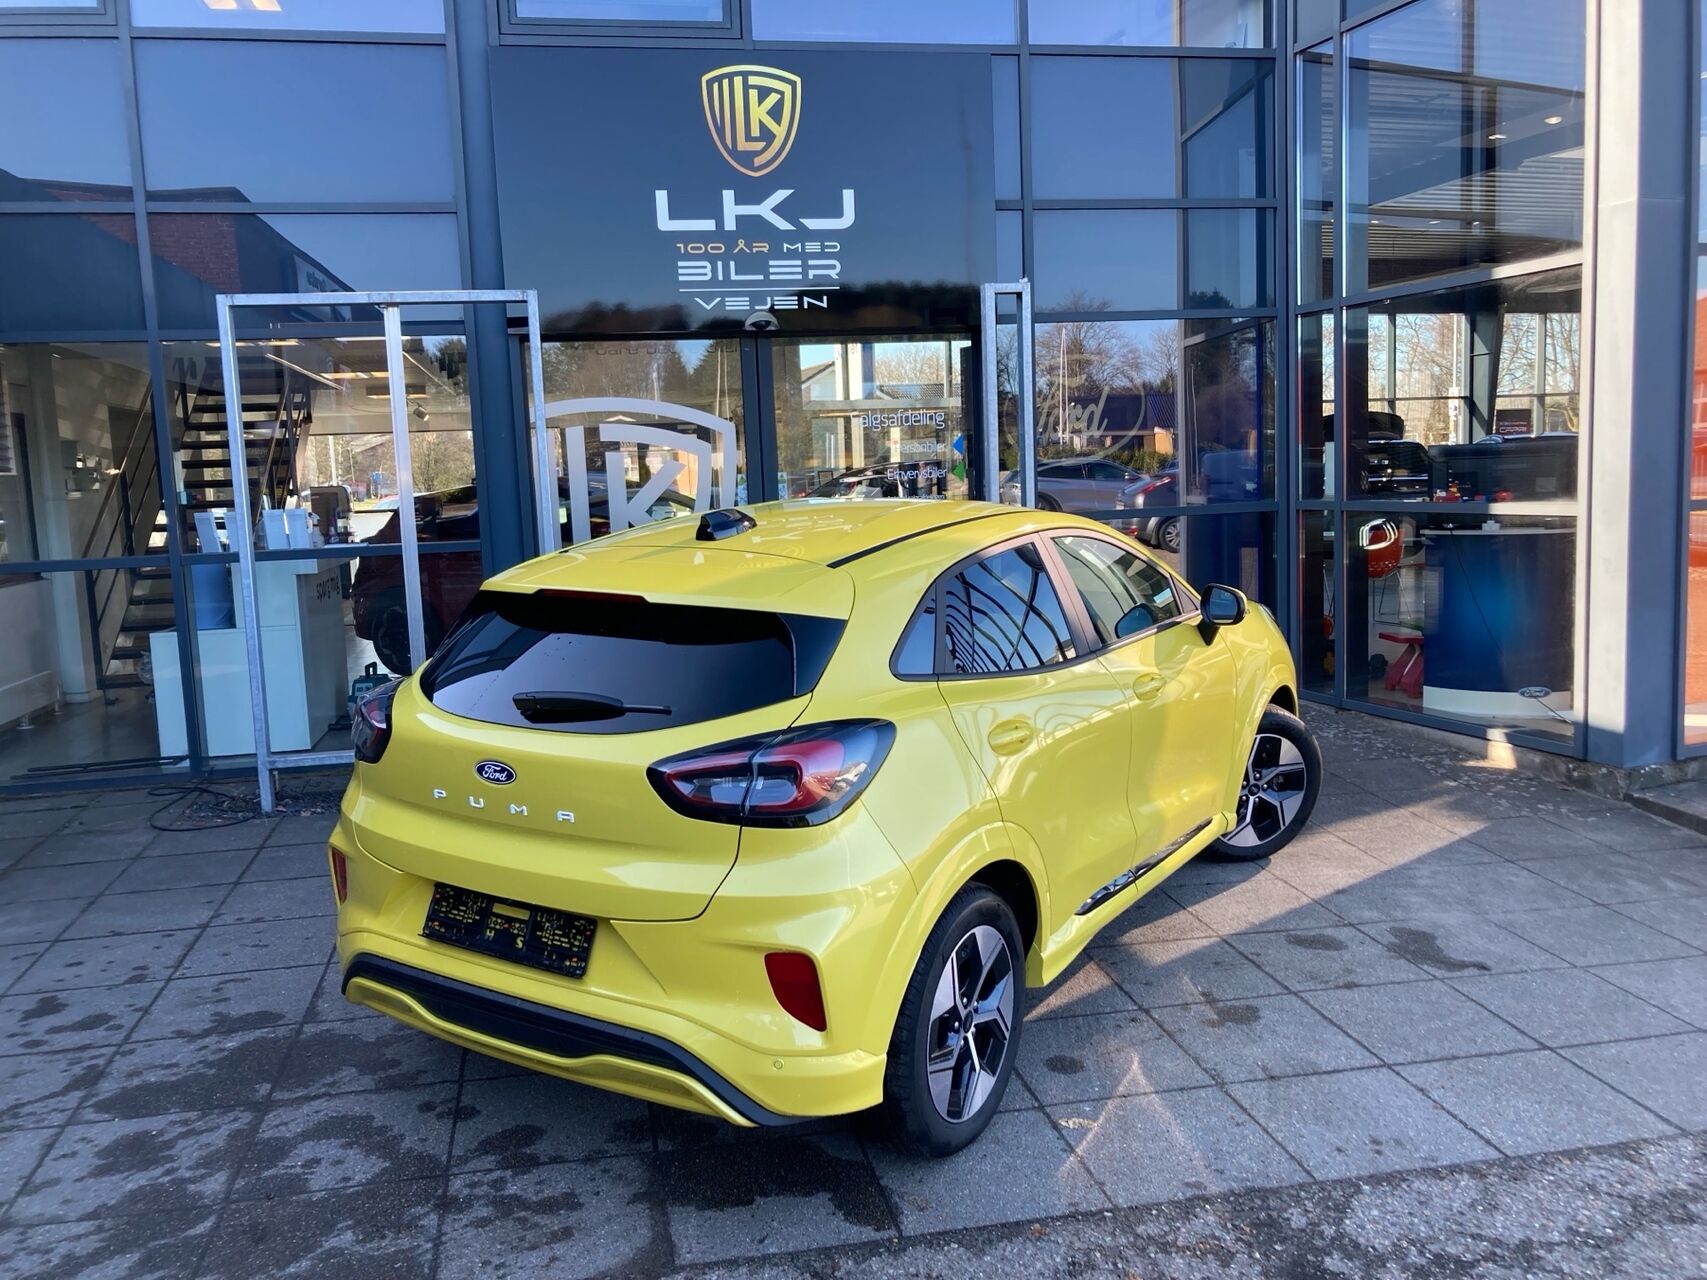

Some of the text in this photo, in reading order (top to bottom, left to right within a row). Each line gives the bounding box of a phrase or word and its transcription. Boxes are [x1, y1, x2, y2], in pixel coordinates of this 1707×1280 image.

[655, 189, 855, 231] LKJ
[676, 239, 841, 254] 100 ÅR MED
[677, 259, 842, 281] BILER
[694, 295, 829, 310] VEJEN
[894, 440, 947, 453] ersonbiler
[482, 764, 508, 782] Ford
[432, 788, 576, 823] PUMA
